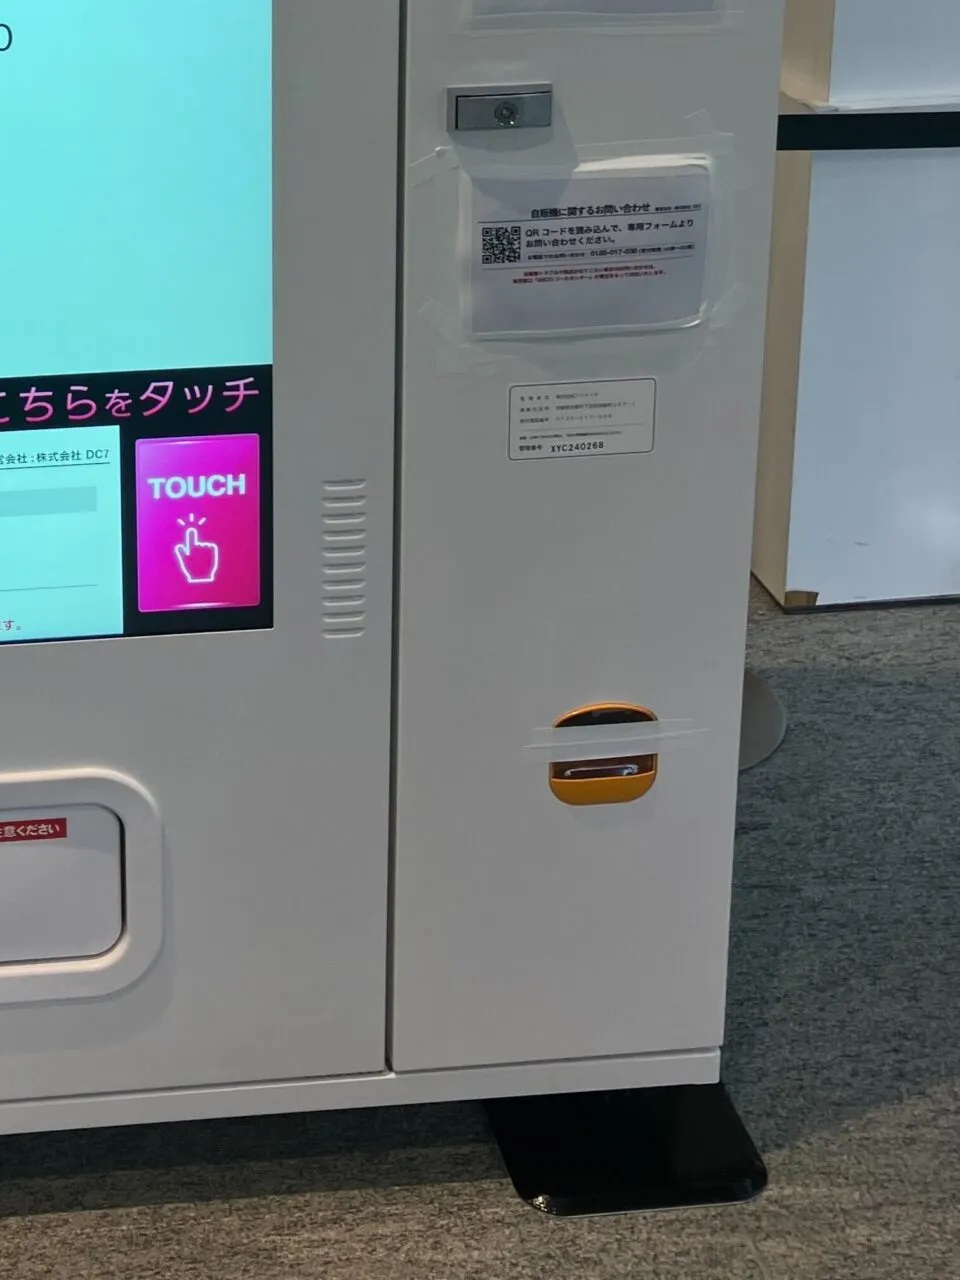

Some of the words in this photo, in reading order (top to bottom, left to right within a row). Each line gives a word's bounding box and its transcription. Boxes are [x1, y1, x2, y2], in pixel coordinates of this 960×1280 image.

[525, 229, 540, 238] QR
[86, 448, 110, 461] DC7
[147, 473, 246, 499] TOUCH
